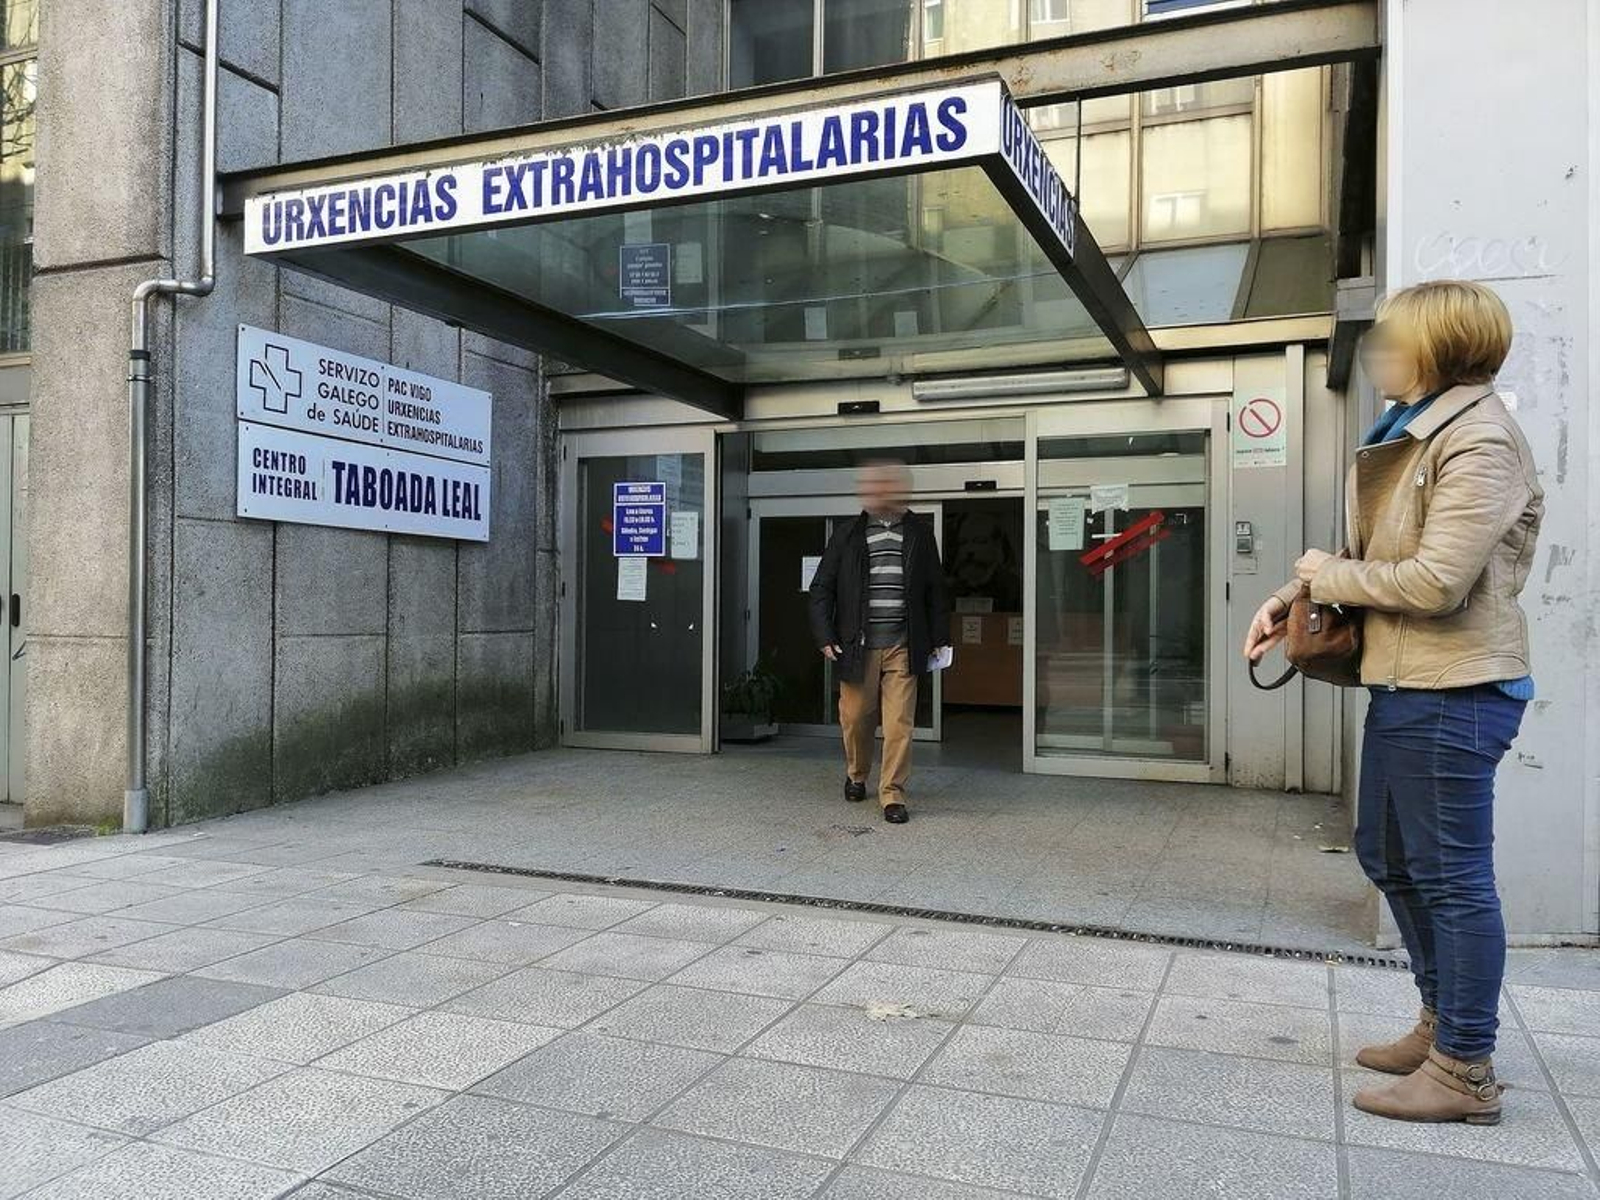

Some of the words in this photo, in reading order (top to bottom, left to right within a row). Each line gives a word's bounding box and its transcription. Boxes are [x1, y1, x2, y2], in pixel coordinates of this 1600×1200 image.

[262, 174, 458, 246] URXENCIAS
[482, 96, 967, 216] EXTRAHOSPITALARIAS
[1002, 97, 1076, 249] URXENCIAS
[318, 358, 380, 388] SERVIZO
[317, 382, 380, 410] GALEGO
[388, 377, 407, 396] PAC
[409, 383, 432, 402] VIGO
[307, 402, 326, 422] de
[333, 407, 379, 433] SAÚDE
[388, 399, 442, 425] URXENCIAS
[387, 420, 484, 455] EXTRAHOSPITALARIAS
[252, 447, 307, 476] CENTRO
[252, 472, 318, 501] INTEGRAL
[331, 460, 437, 516] TABOADA
[442, 478, 482, 521] LEAL
